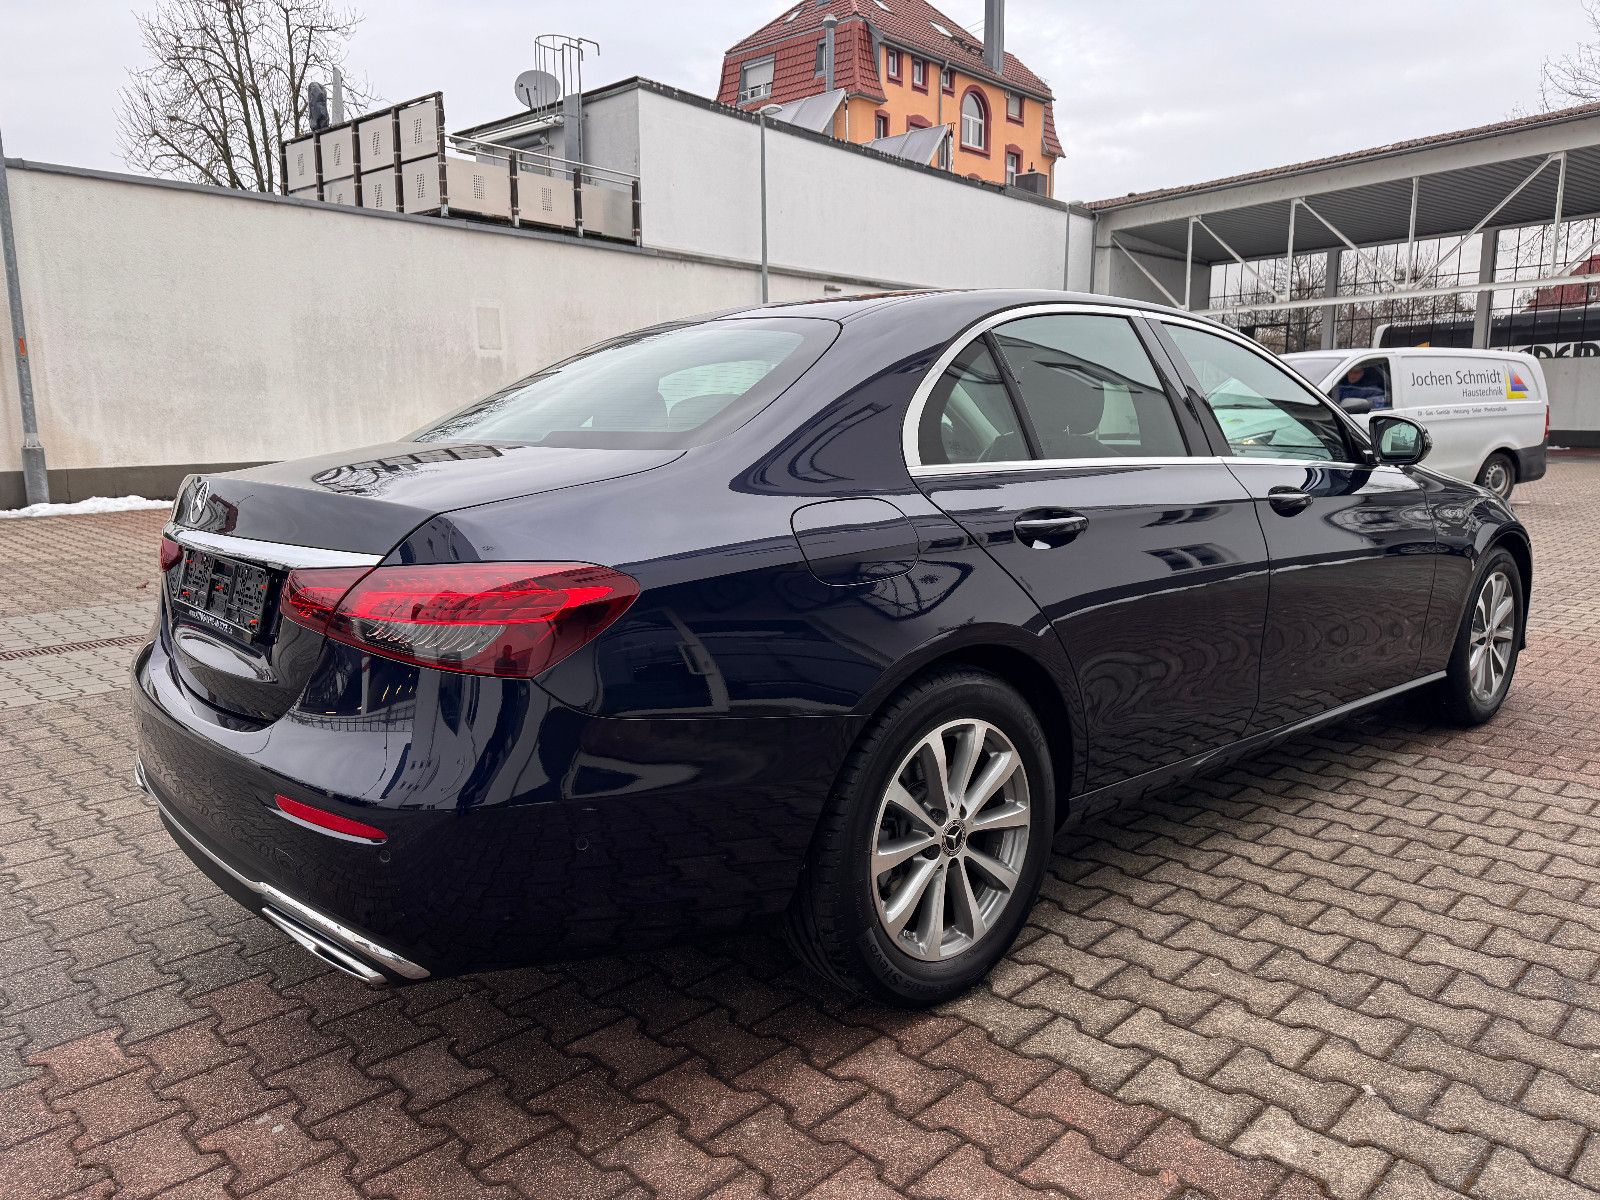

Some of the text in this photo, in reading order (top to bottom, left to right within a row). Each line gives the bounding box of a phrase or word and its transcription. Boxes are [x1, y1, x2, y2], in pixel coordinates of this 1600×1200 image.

[1411, 369, 1502, 387] Jochen Schmidt
[1462, 386, 1504, 398] Haustechnik
